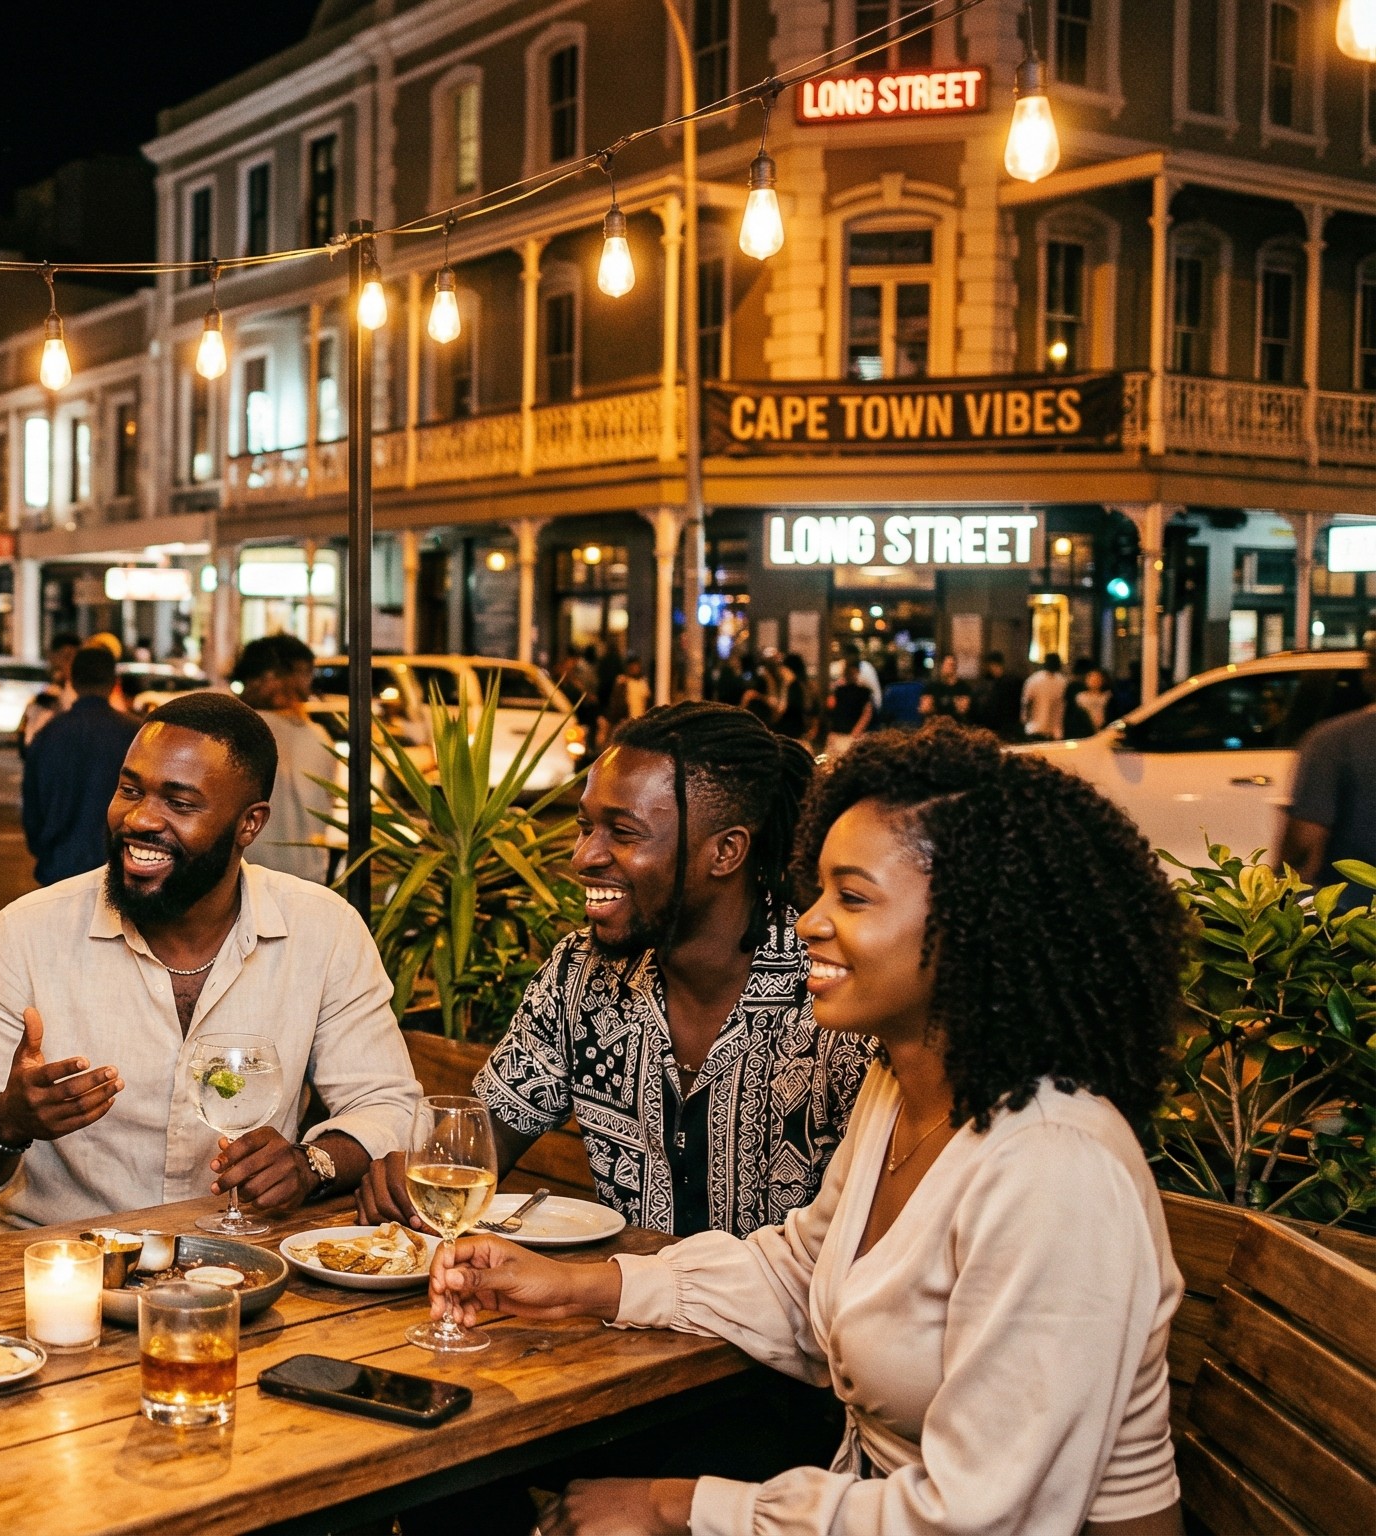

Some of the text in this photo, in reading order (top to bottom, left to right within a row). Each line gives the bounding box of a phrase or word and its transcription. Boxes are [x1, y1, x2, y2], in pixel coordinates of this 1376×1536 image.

[803, 71, 981, 118] LONG STREET
[730, 389, 1082, 440] CAPE TOWN VIBES
[769, 515, 1038, 565] LONG STREET
